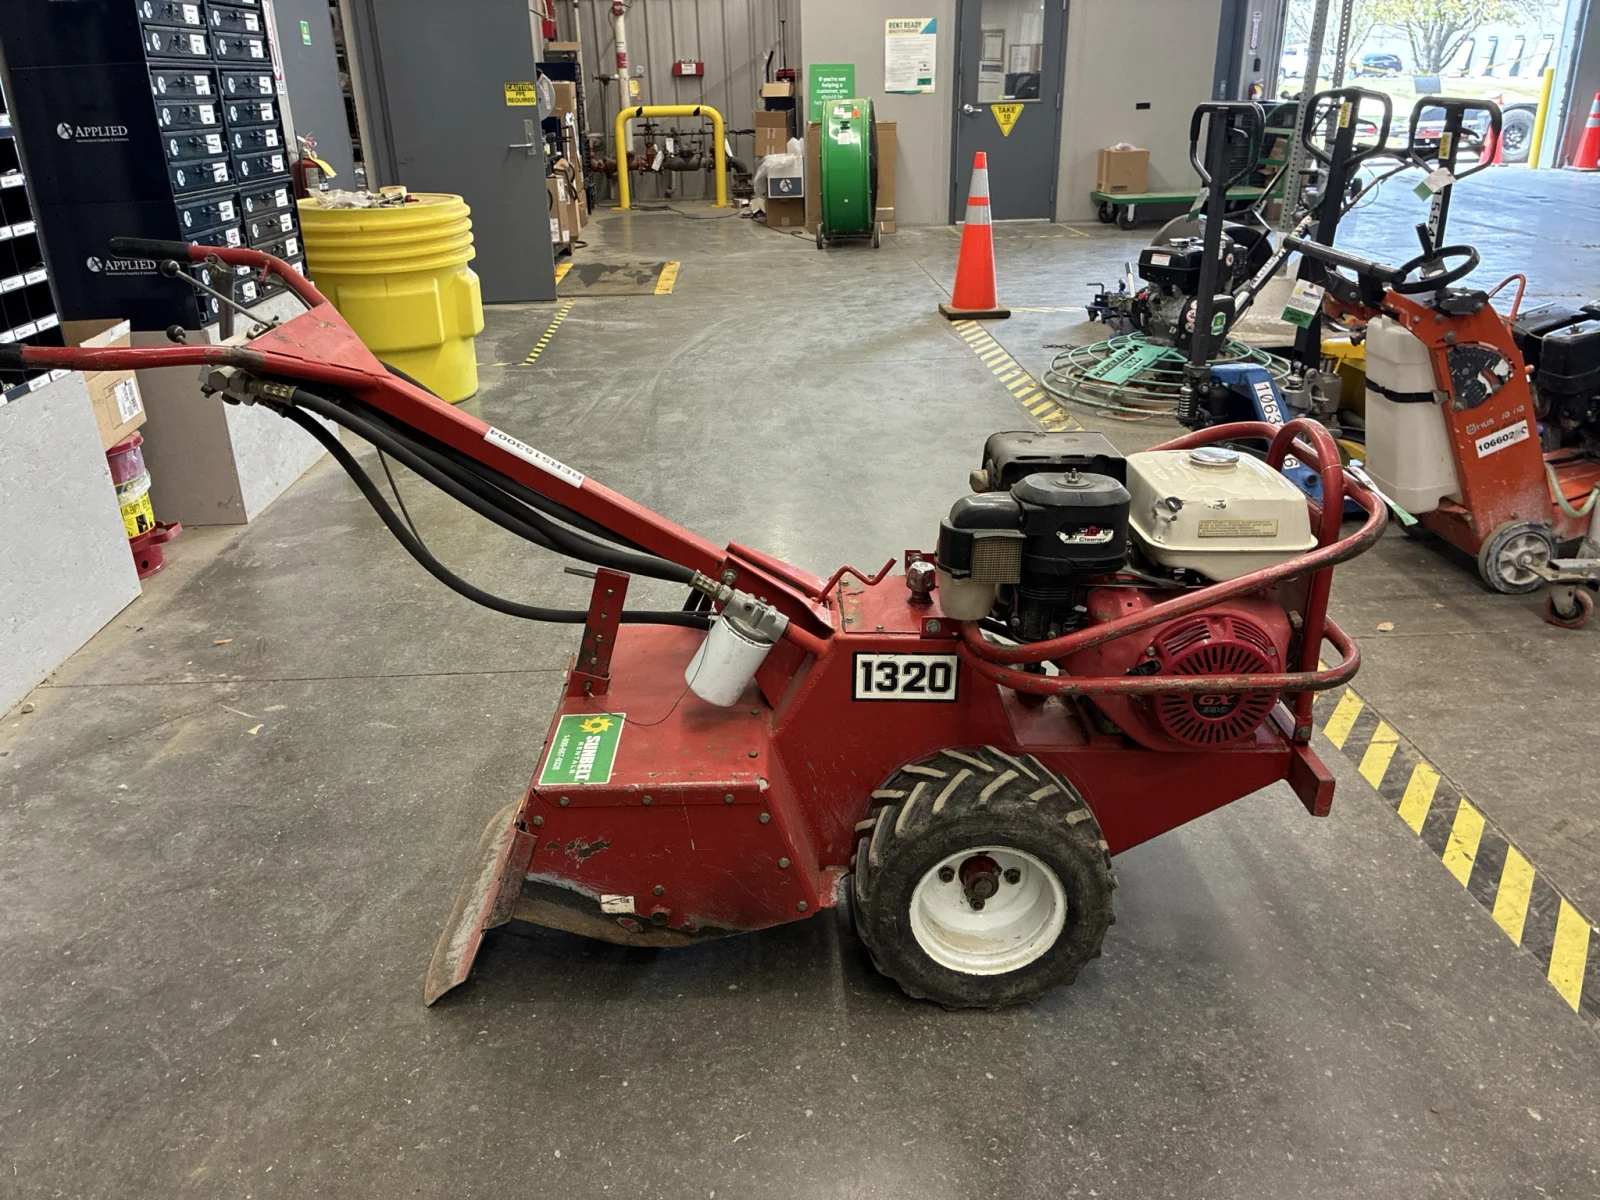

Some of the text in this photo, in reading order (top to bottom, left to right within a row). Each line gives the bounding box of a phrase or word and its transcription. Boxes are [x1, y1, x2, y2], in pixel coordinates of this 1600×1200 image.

[888, 21, 922, 29] RENT READY
[998, 106, 1016, 114] TAKE
[75, 125, 128, 137] APPLIED
[105, 259, 157, 271] APPLIED
[490, 429, 582, 480] RER5153004
[860, 660, 953, 694] 1320
[1198, 694, 1236, 706] GX
[569, 741, 585, 774] RENTALS
[577, 735, 601, 781] SUNBELT
